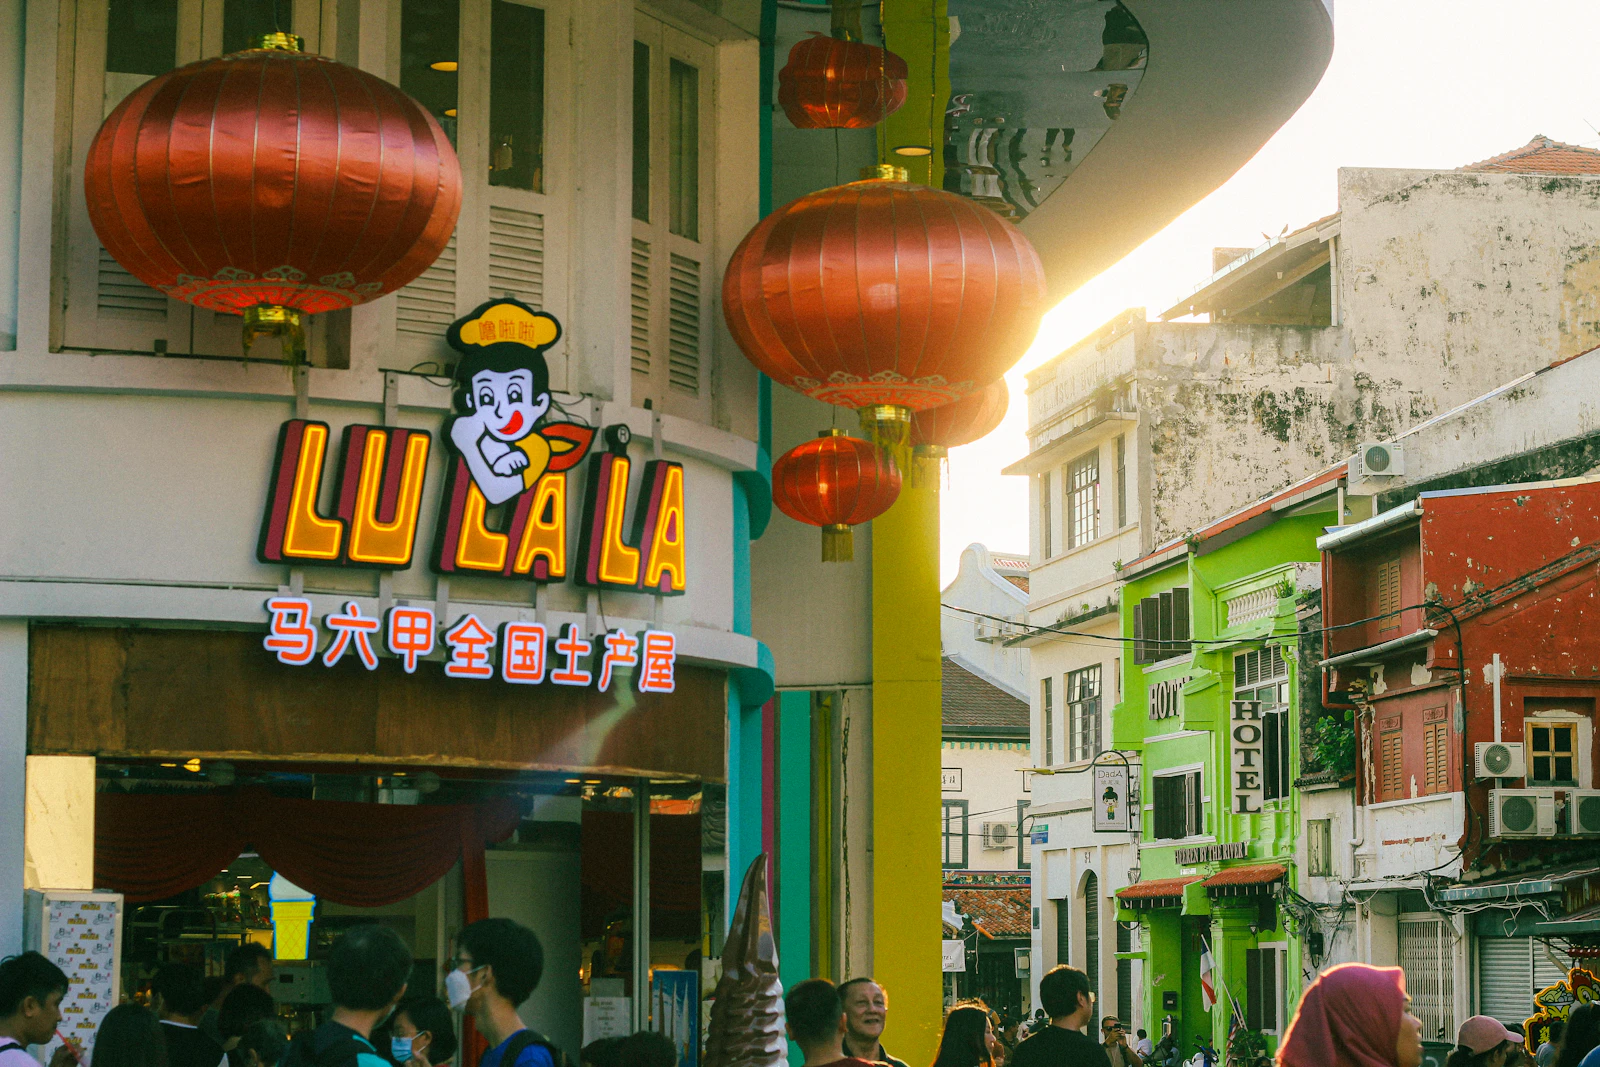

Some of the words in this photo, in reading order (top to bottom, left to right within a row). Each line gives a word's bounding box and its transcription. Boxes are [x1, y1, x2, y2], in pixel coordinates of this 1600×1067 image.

[264, 597, 676, 693] 马六甲全国土产屋
[1232, 701, 1263, 814] HOTEL
[1208, 844, 1222, 861] THE
